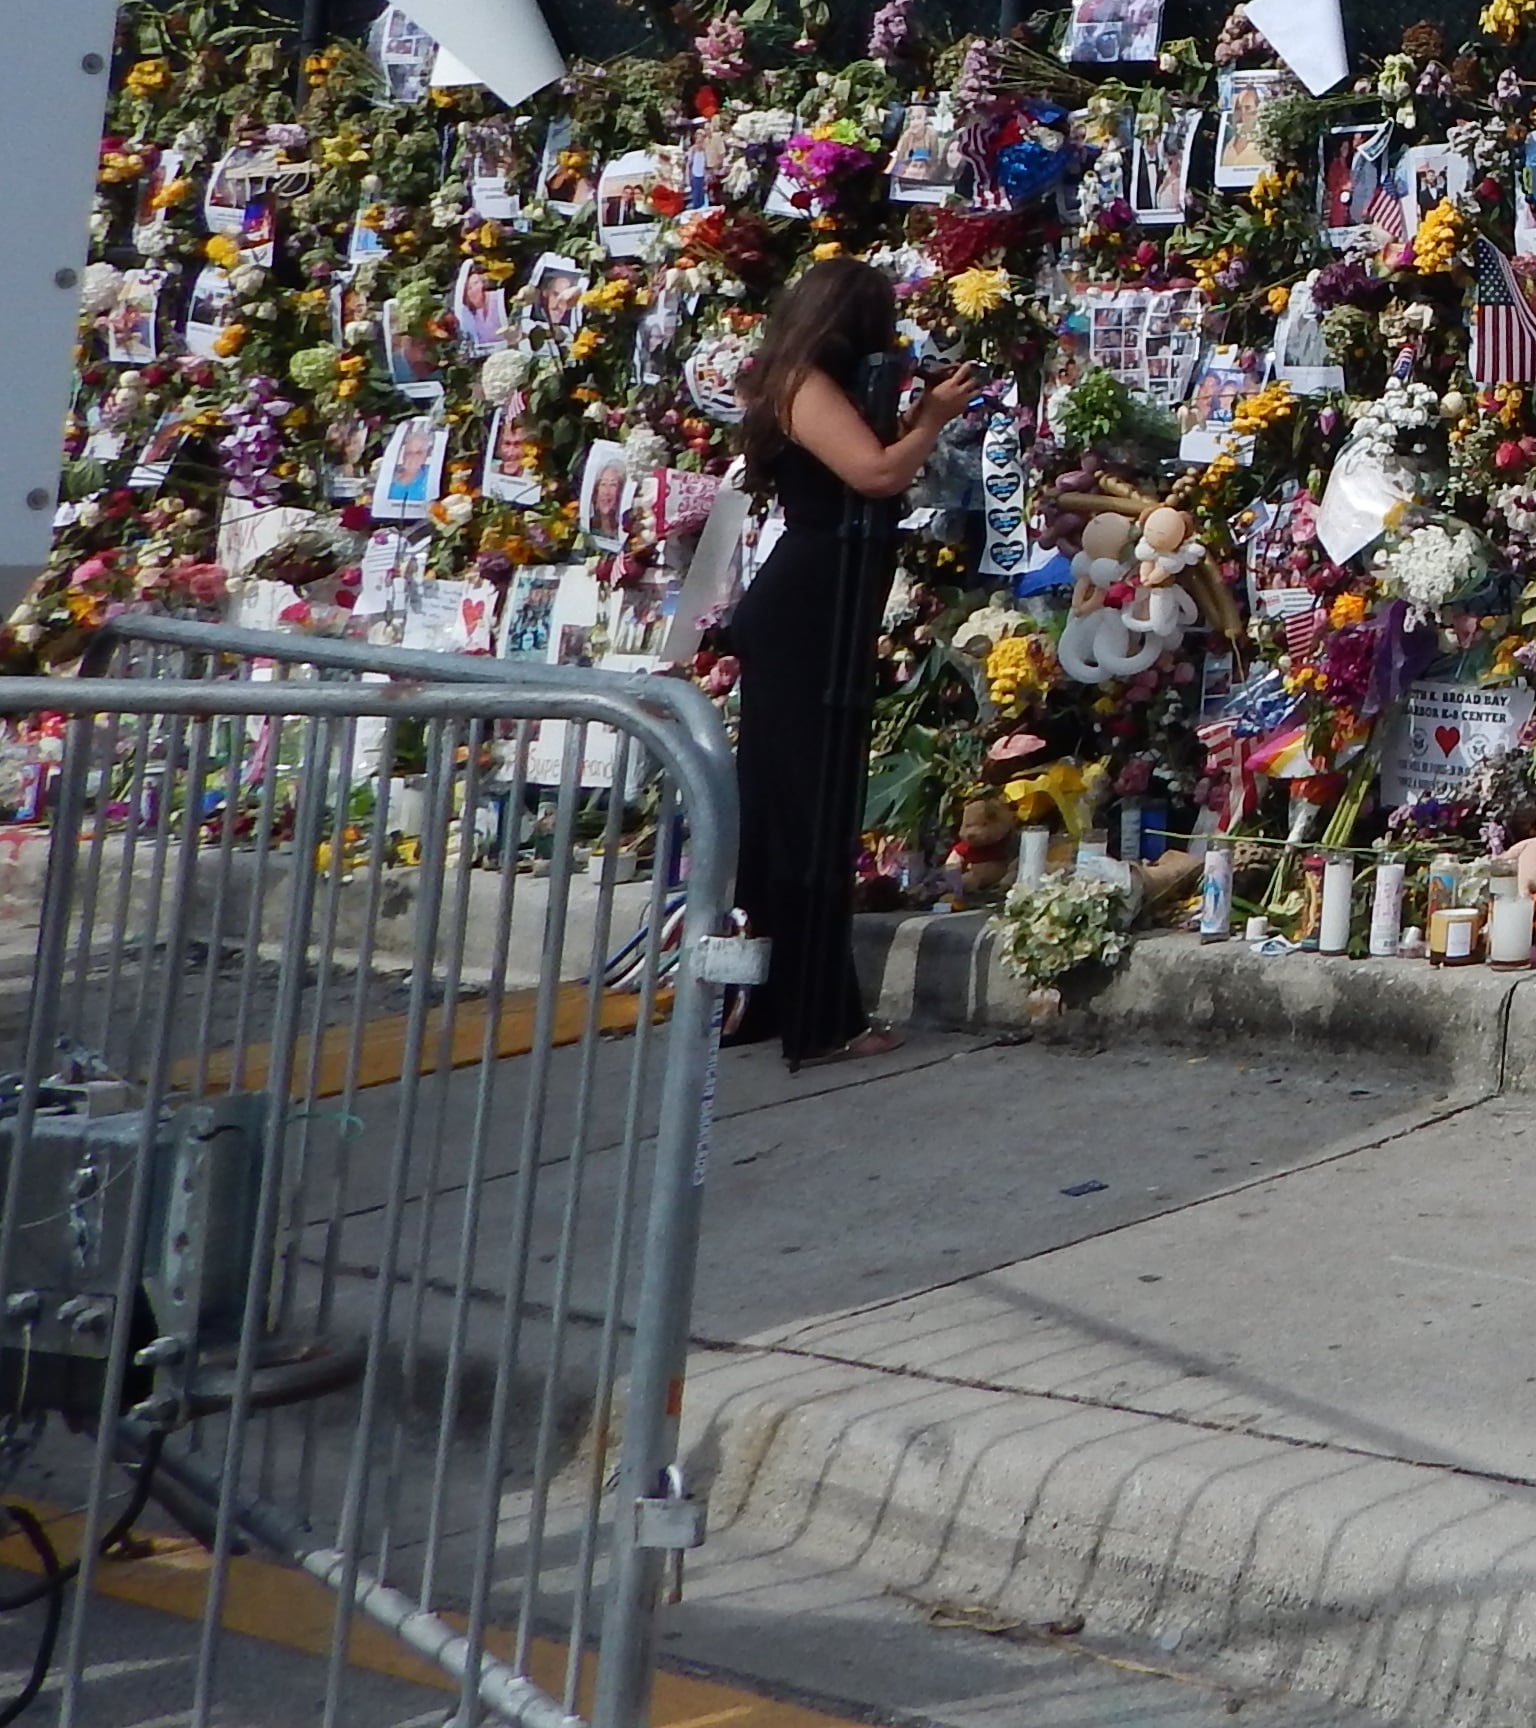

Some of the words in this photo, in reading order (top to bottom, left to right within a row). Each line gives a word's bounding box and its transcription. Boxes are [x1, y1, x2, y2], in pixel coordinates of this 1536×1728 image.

[1443, 692, 1481, 705] BROAD
[1484, 695, 1508, 707] BAY
[1461, 710, 1507, 724] CENTER
